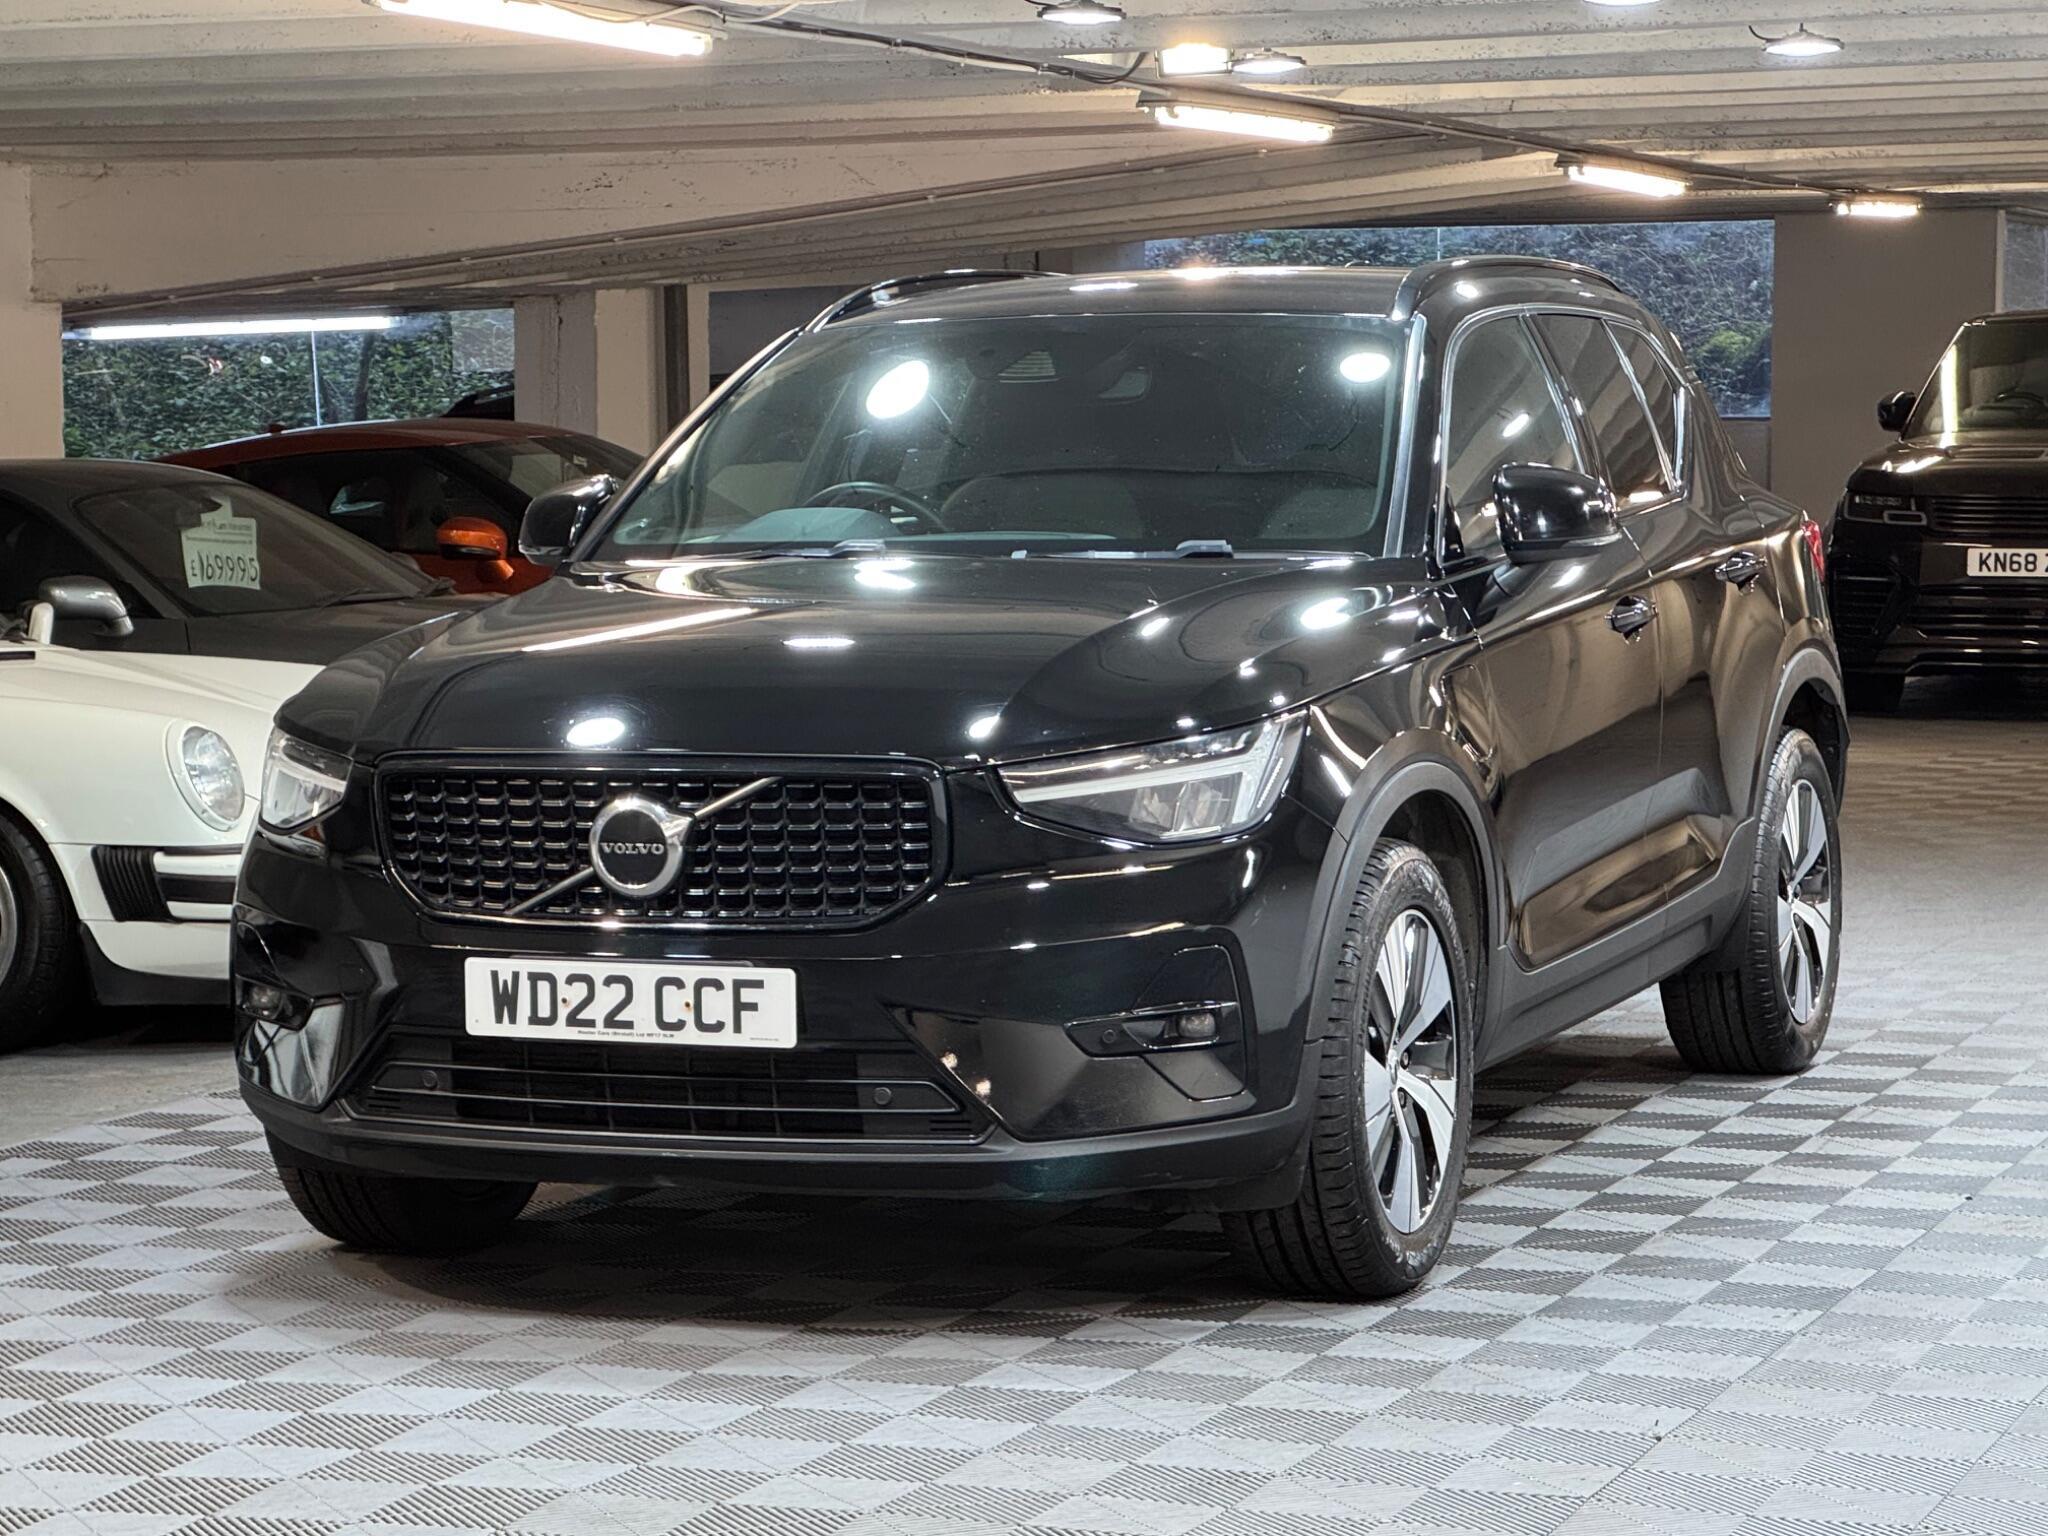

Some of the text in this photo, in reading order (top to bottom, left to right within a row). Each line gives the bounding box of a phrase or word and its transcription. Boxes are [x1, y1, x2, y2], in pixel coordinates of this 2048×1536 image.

[190, 550, 258, 582] £169995
[1978, 552, 2038, 573] KN68
[600, 842, 665, 855] VOLVO
[490, 970, 765, 1034] WD22 CCF
